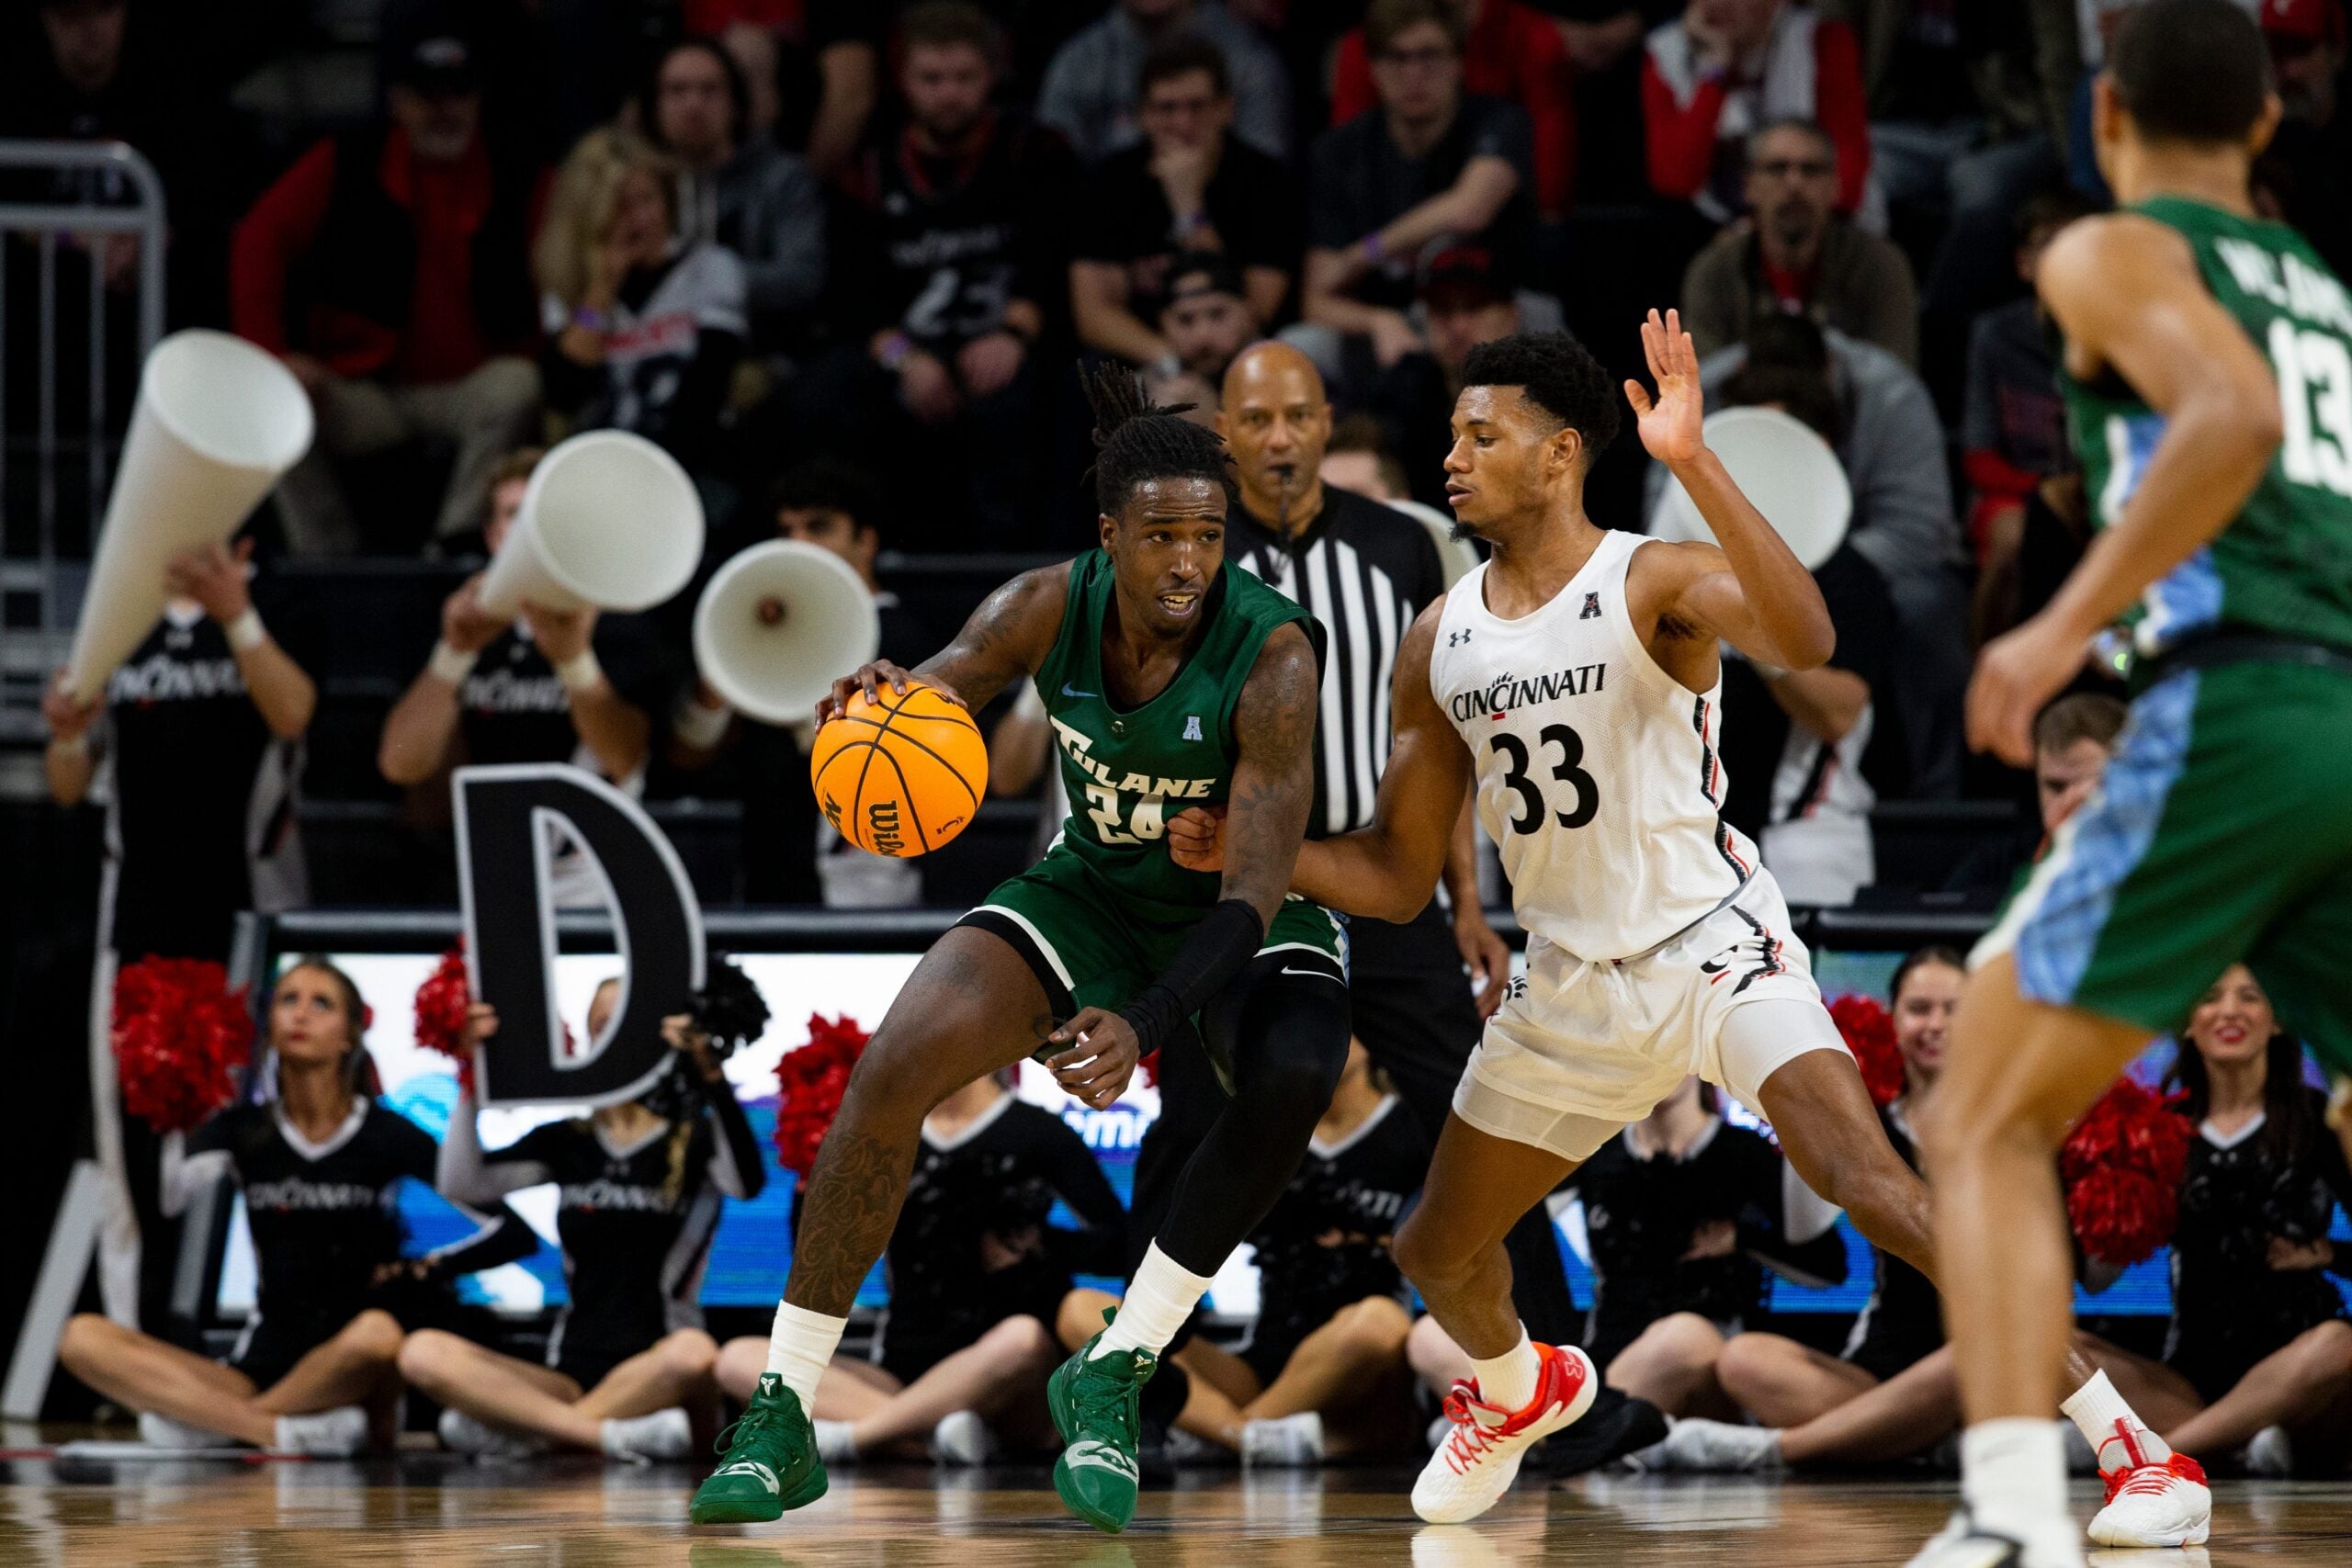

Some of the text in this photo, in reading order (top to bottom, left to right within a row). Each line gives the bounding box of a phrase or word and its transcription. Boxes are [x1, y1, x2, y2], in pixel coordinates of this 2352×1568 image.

[1453, 663, 1606, 722] CINCINNATI
[1050, 715, 1217, 798] TULANE
[1490, 724, 1600, 835] 33
[450, 762, 707, 1108] D
